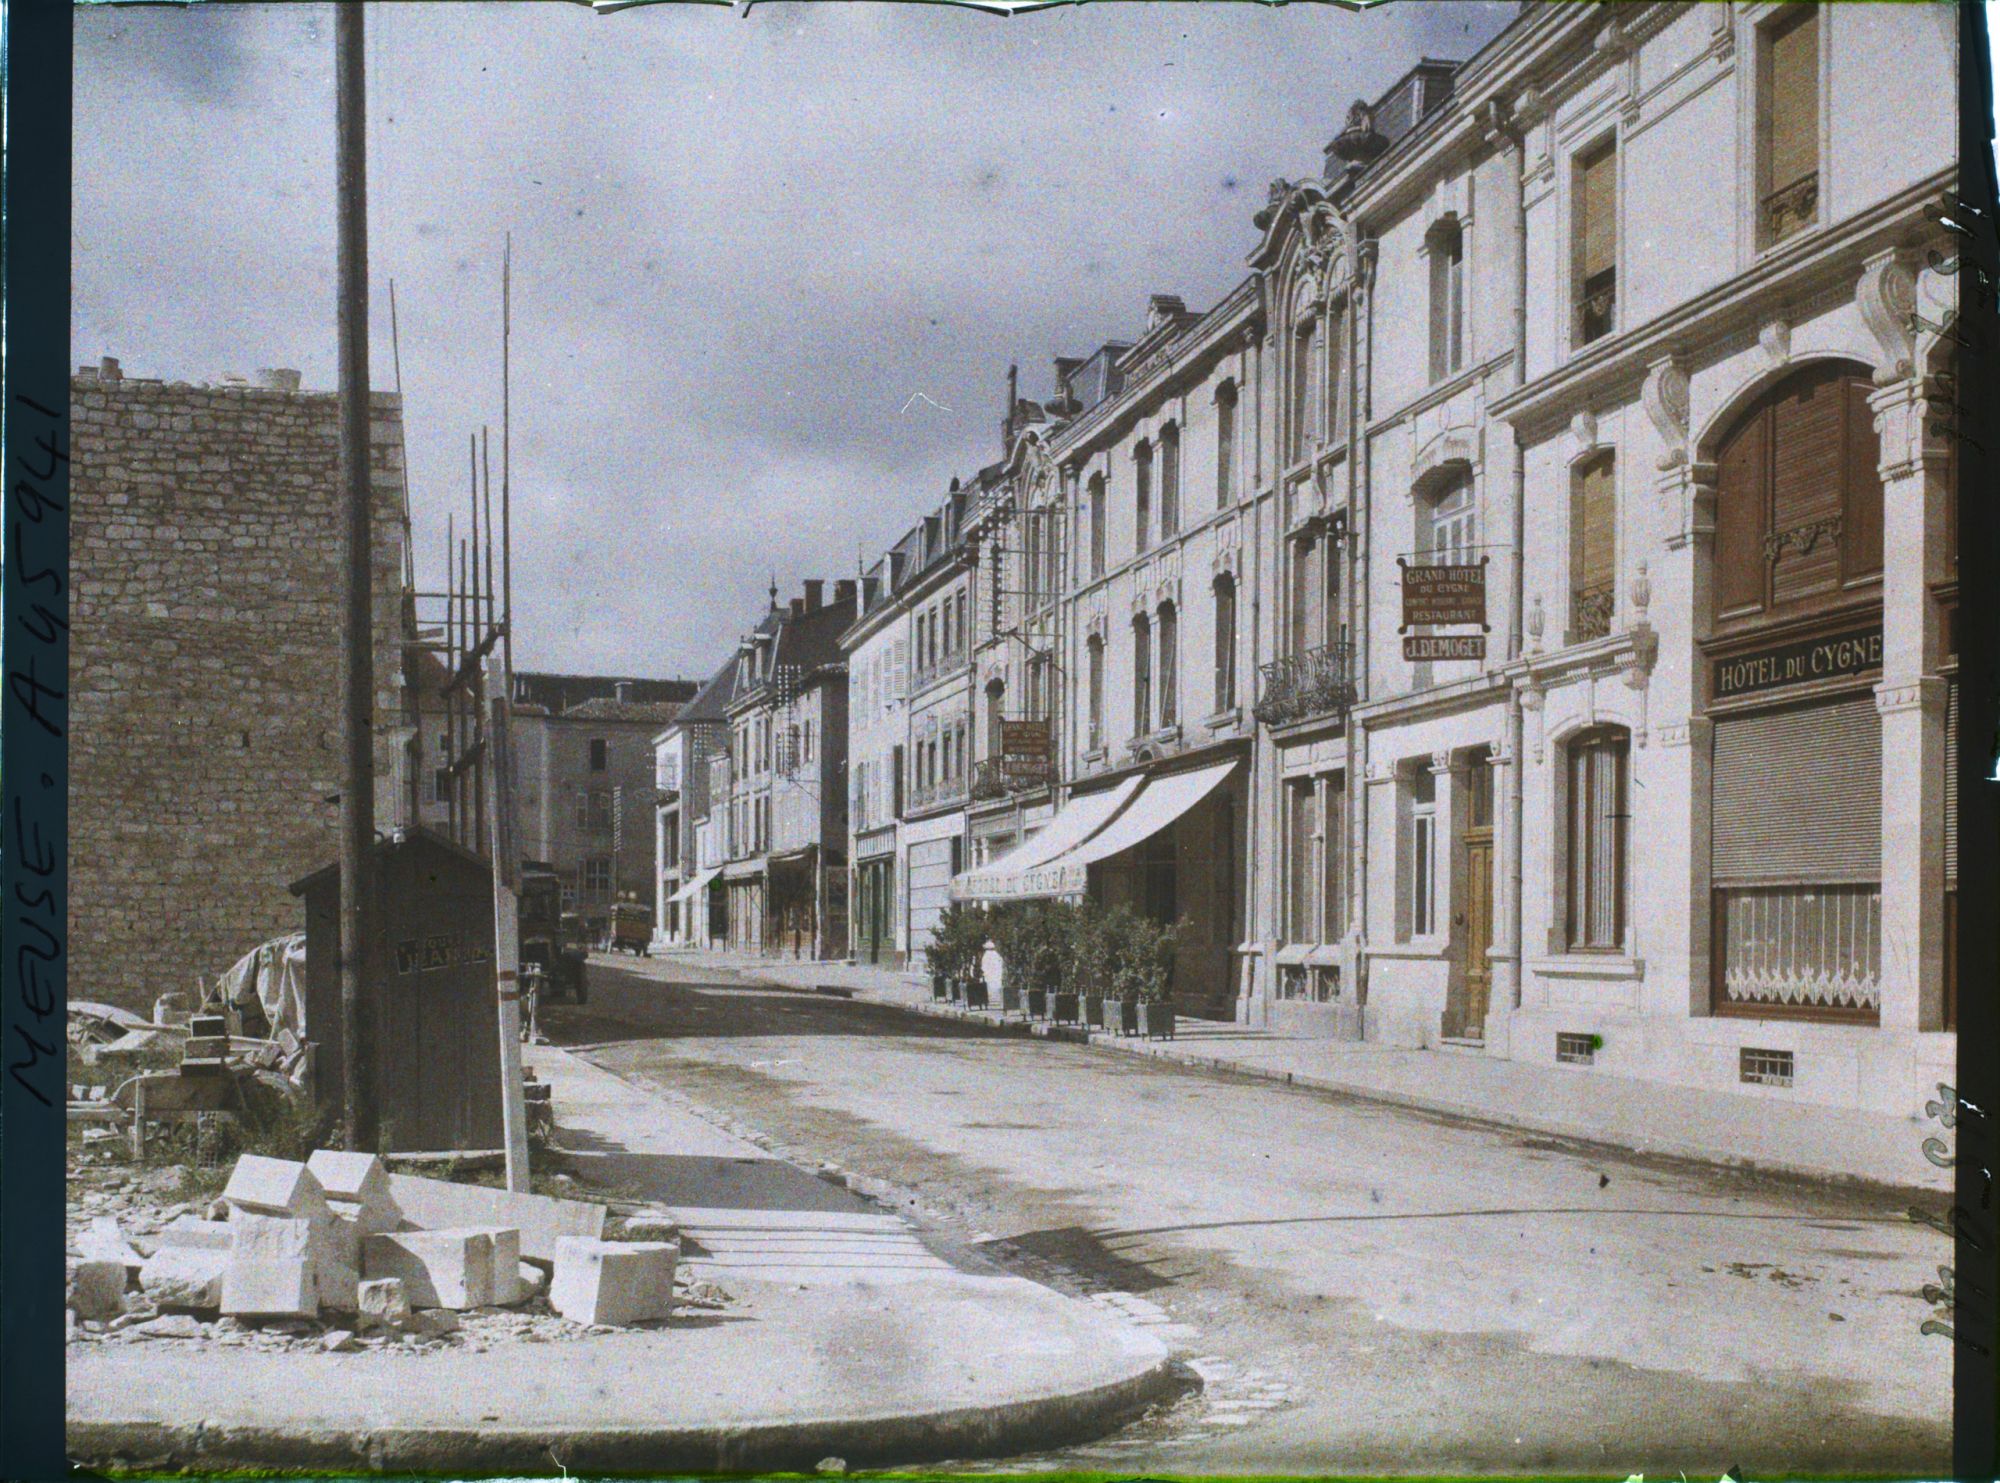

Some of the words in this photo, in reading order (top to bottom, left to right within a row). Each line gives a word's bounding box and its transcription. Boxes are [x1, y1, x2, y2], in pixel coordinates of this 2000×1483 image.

[1406, 569, 1445, 584] GRAND
[1413, 609, 1476, 621] RESTAURANT
[1786, 656, 1805, 678] DU
[1811, 634, 1882, 673] CYGNE
